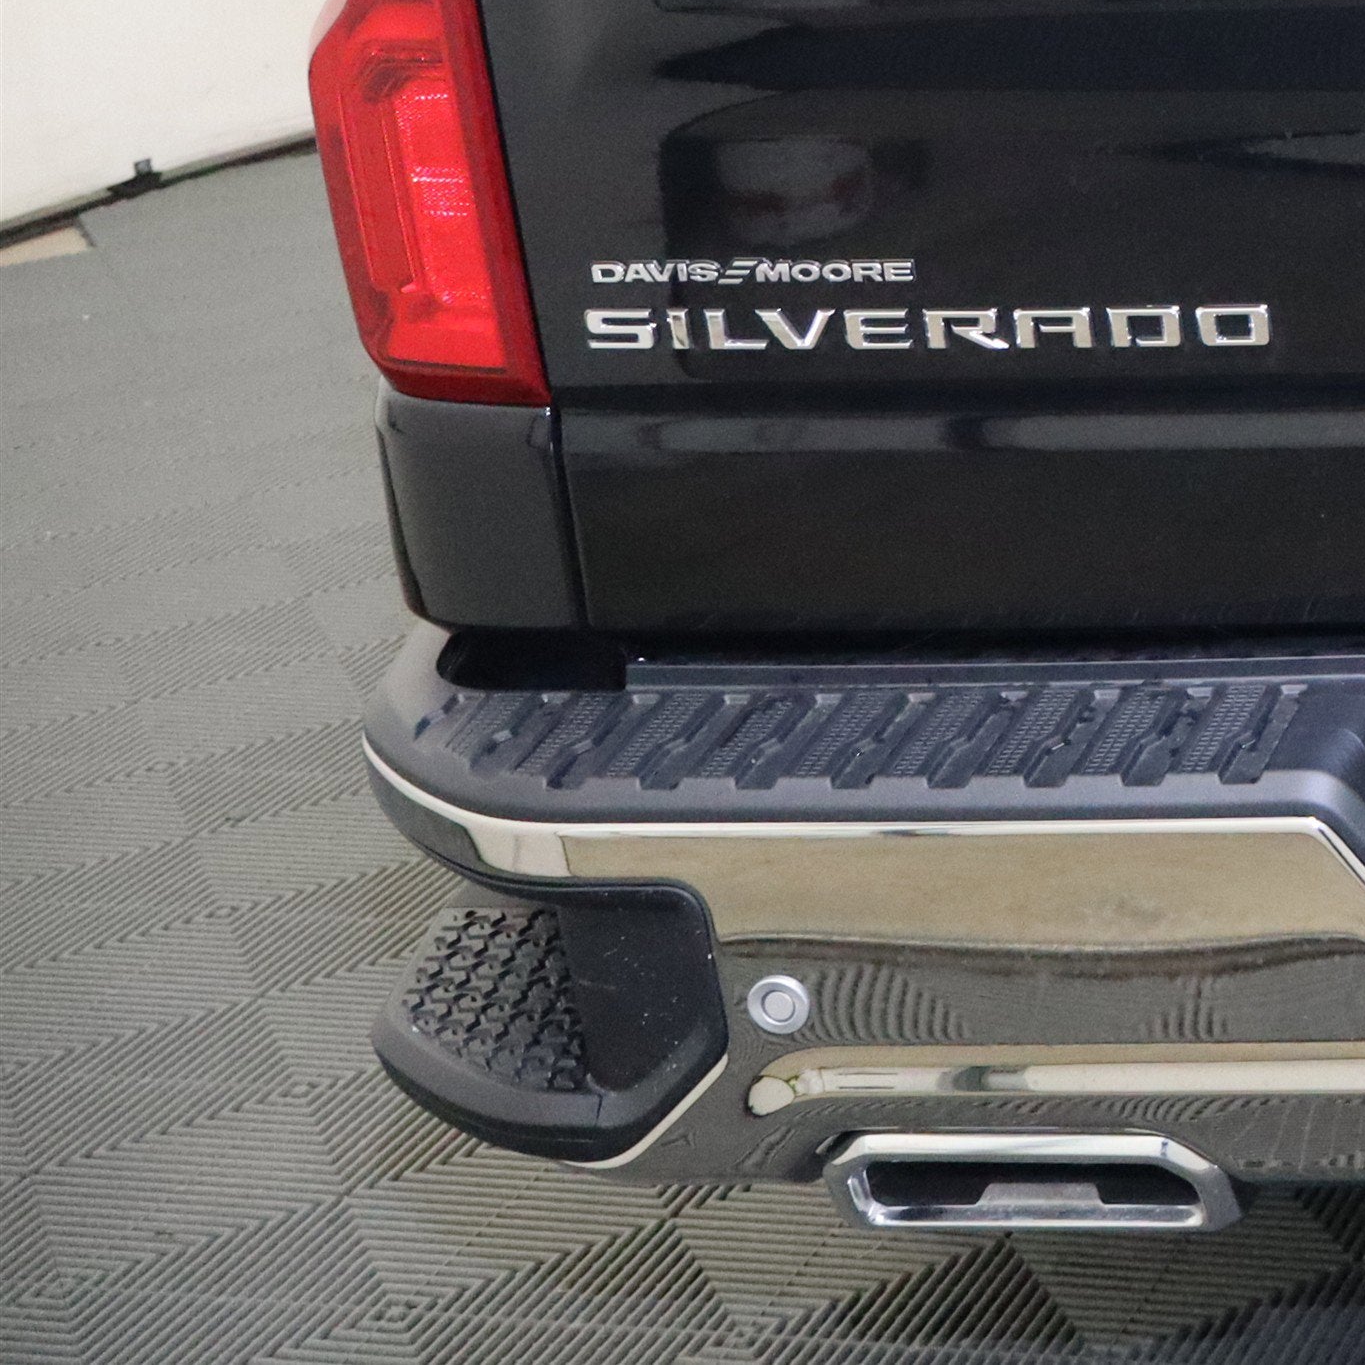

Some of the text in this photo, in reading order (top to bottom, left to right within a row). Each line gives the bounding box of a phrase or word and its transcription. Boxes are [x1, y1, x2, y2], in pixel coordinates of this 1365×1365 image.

[589, 257, 917, 285] DAVIS MOORE
[583, 304, 1274, 351] SILVERADO
